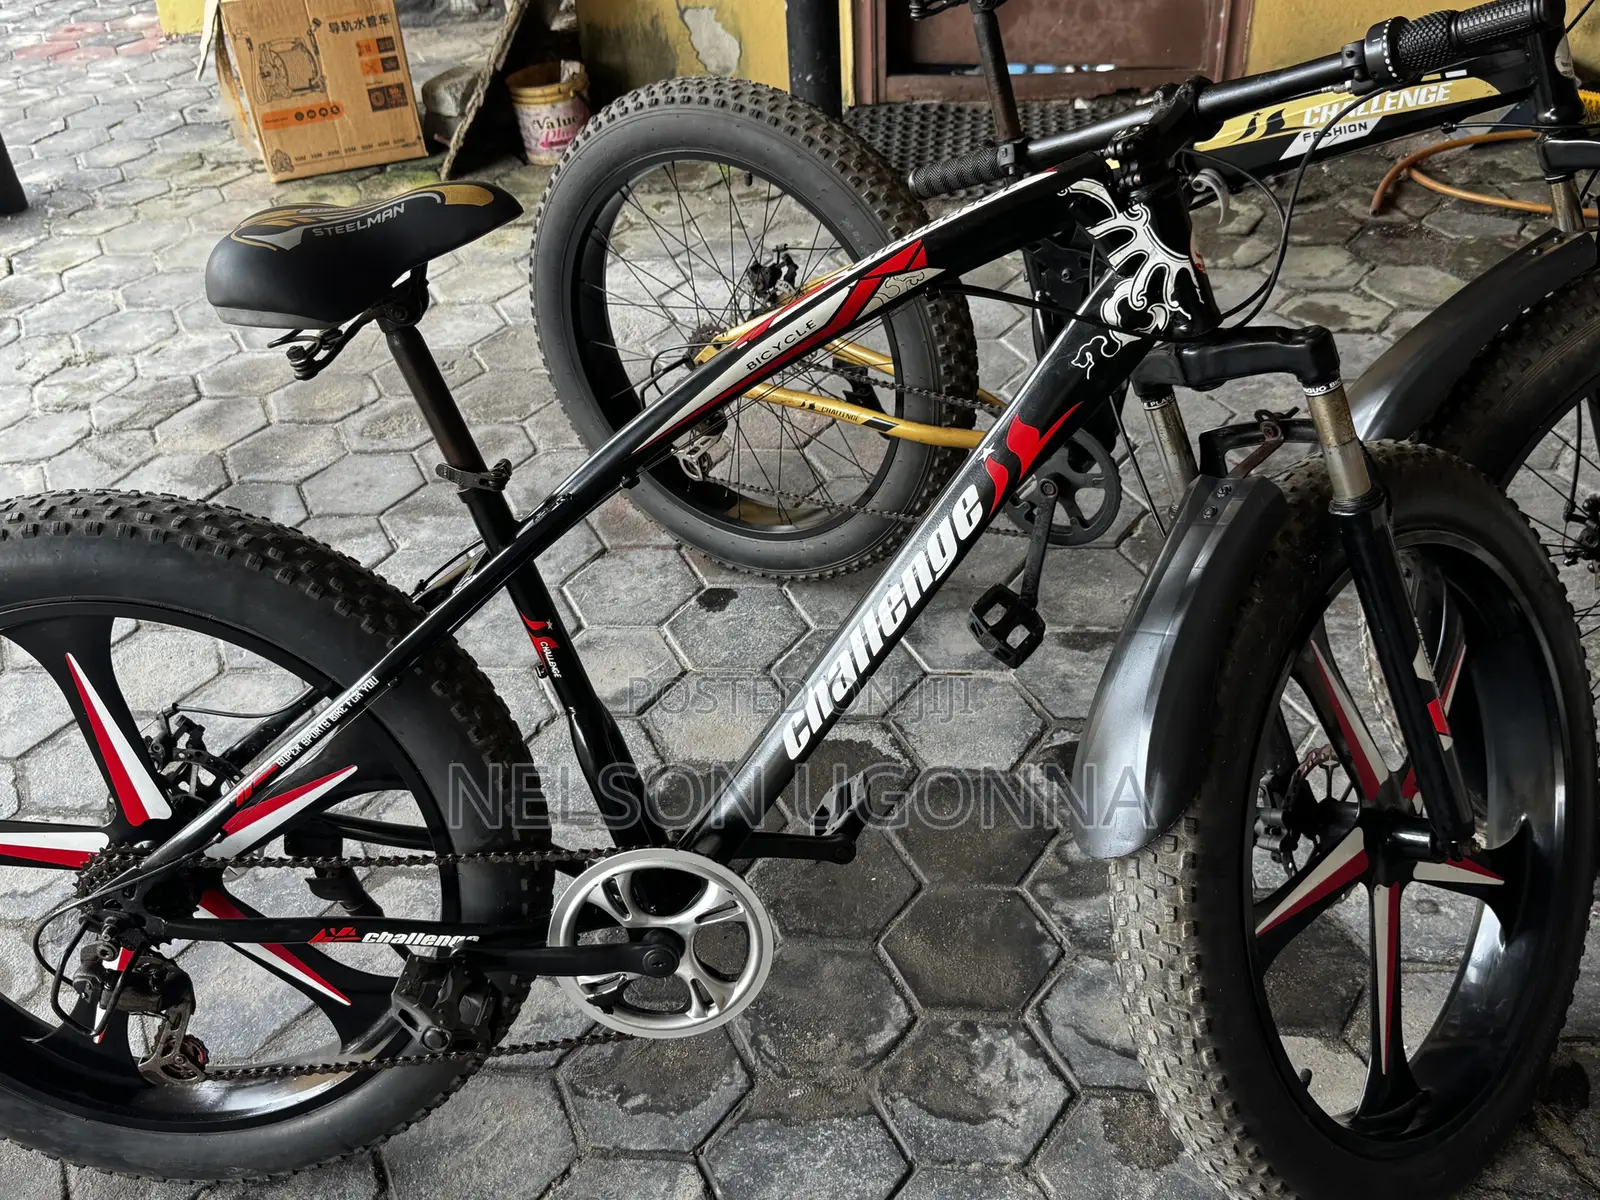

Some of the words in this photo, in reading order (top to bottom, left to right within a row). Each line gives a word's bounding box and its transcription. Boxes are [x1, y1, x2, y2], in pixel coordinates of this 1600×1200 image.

[1302, 83, 1453, 127] CHALLENGE
[1303, 121, 1368, 142] FASHION
[312, 203, 405, 237] STEELMAN
[746, 319, 817, 371] BICYCLE
[821, 406, 859, 422] CHALLENGE
[783, 484, 983, 760] challenge
[540, 641, 562, 678] CHALLENGE
[277, 743, 304, 767] SUPER
[301, 720, 331, 747] SPORTS
[329, 703, 348, 722] BIKE
[361, 675, 380, 692] YOU
